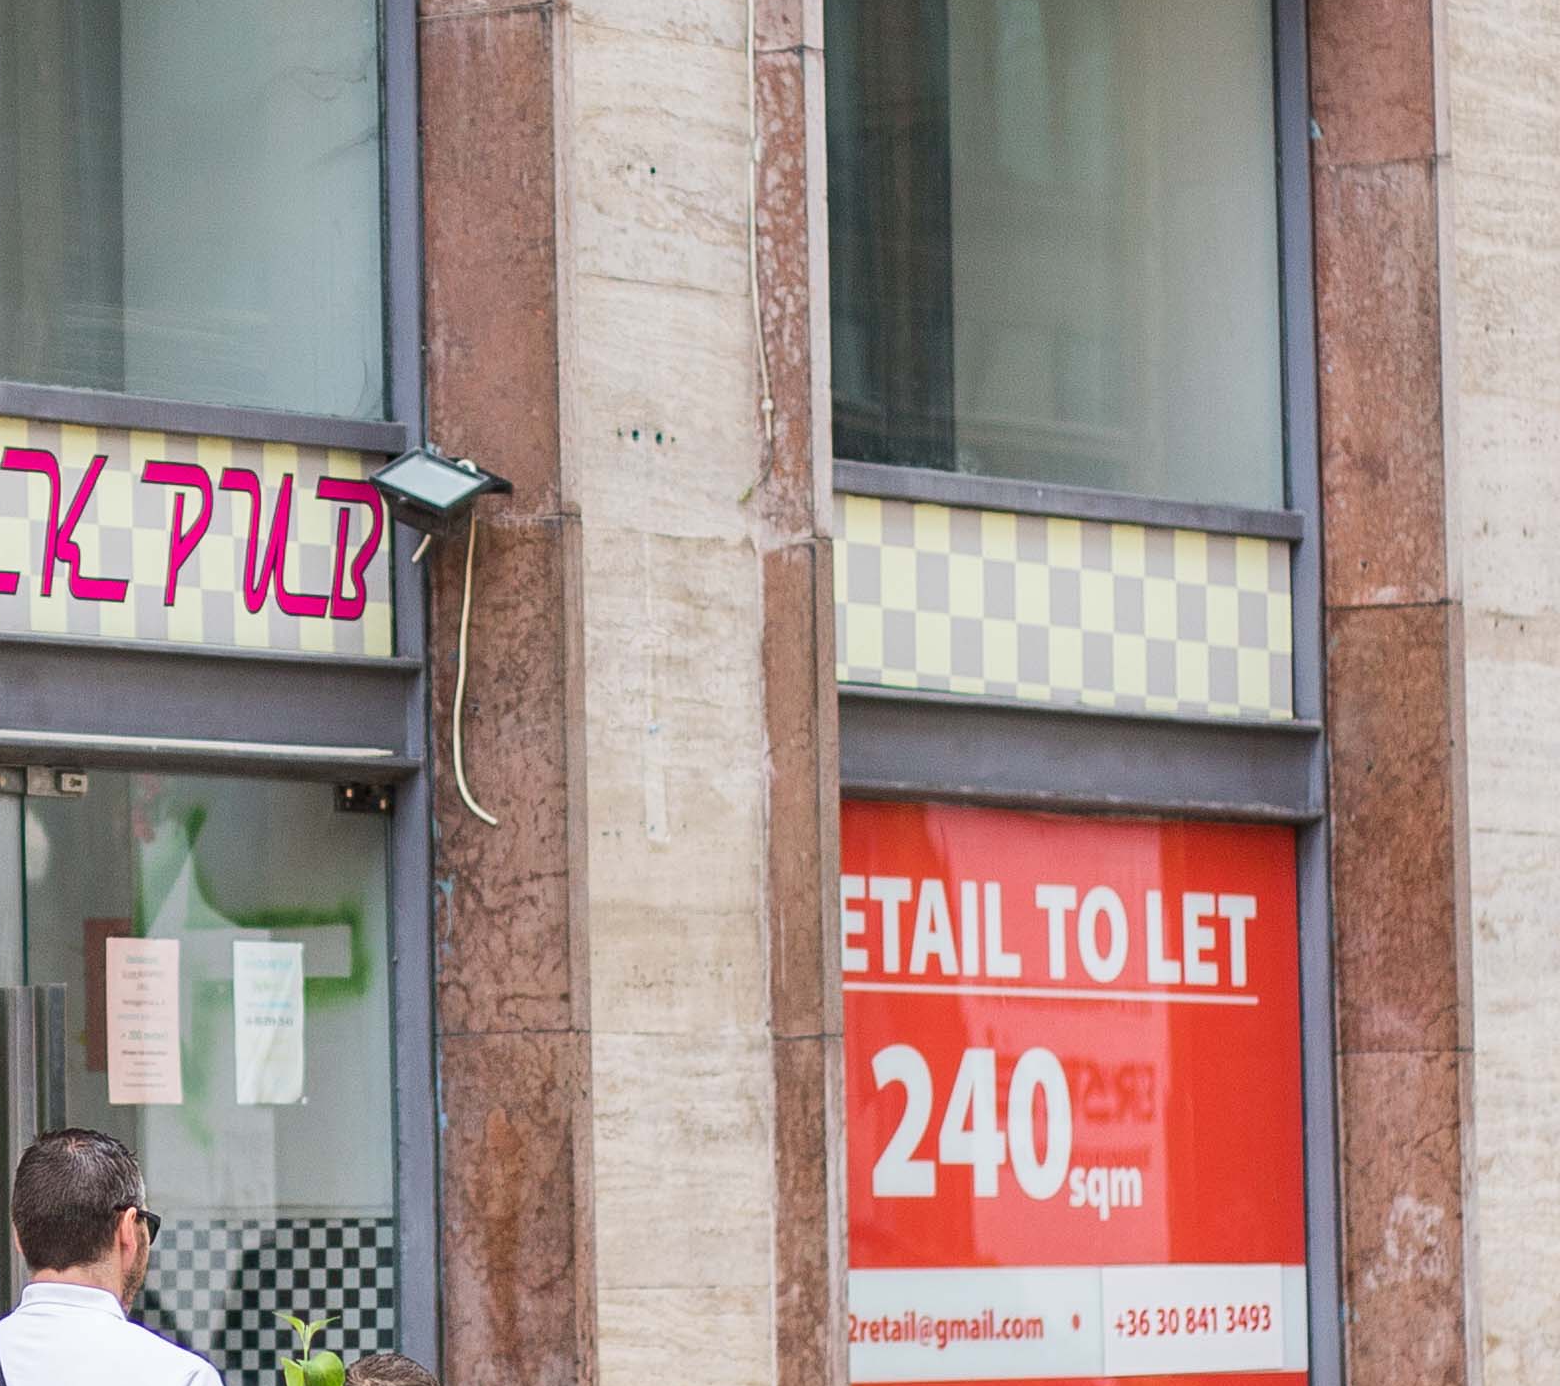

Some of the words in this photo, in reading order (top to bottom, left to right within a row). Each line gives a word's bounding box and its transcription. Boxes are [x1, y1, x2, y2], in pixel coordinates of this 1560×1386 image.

[142, 458, 384, 621] PUB
[1036, 884, 1128, 984] TO
[1146, 890, 1258, 988] LET
[871, 1043, 1073, 1201] 240
[1069, 1164, 1143, 1220] sqm
[1115, 1309, 1151, 1338] +36
[1156, 1307, 1180, 1335] 30
[1185, 1306, 1218, 1334] 841
[1226, 1304, 1272, 1332] 3493
